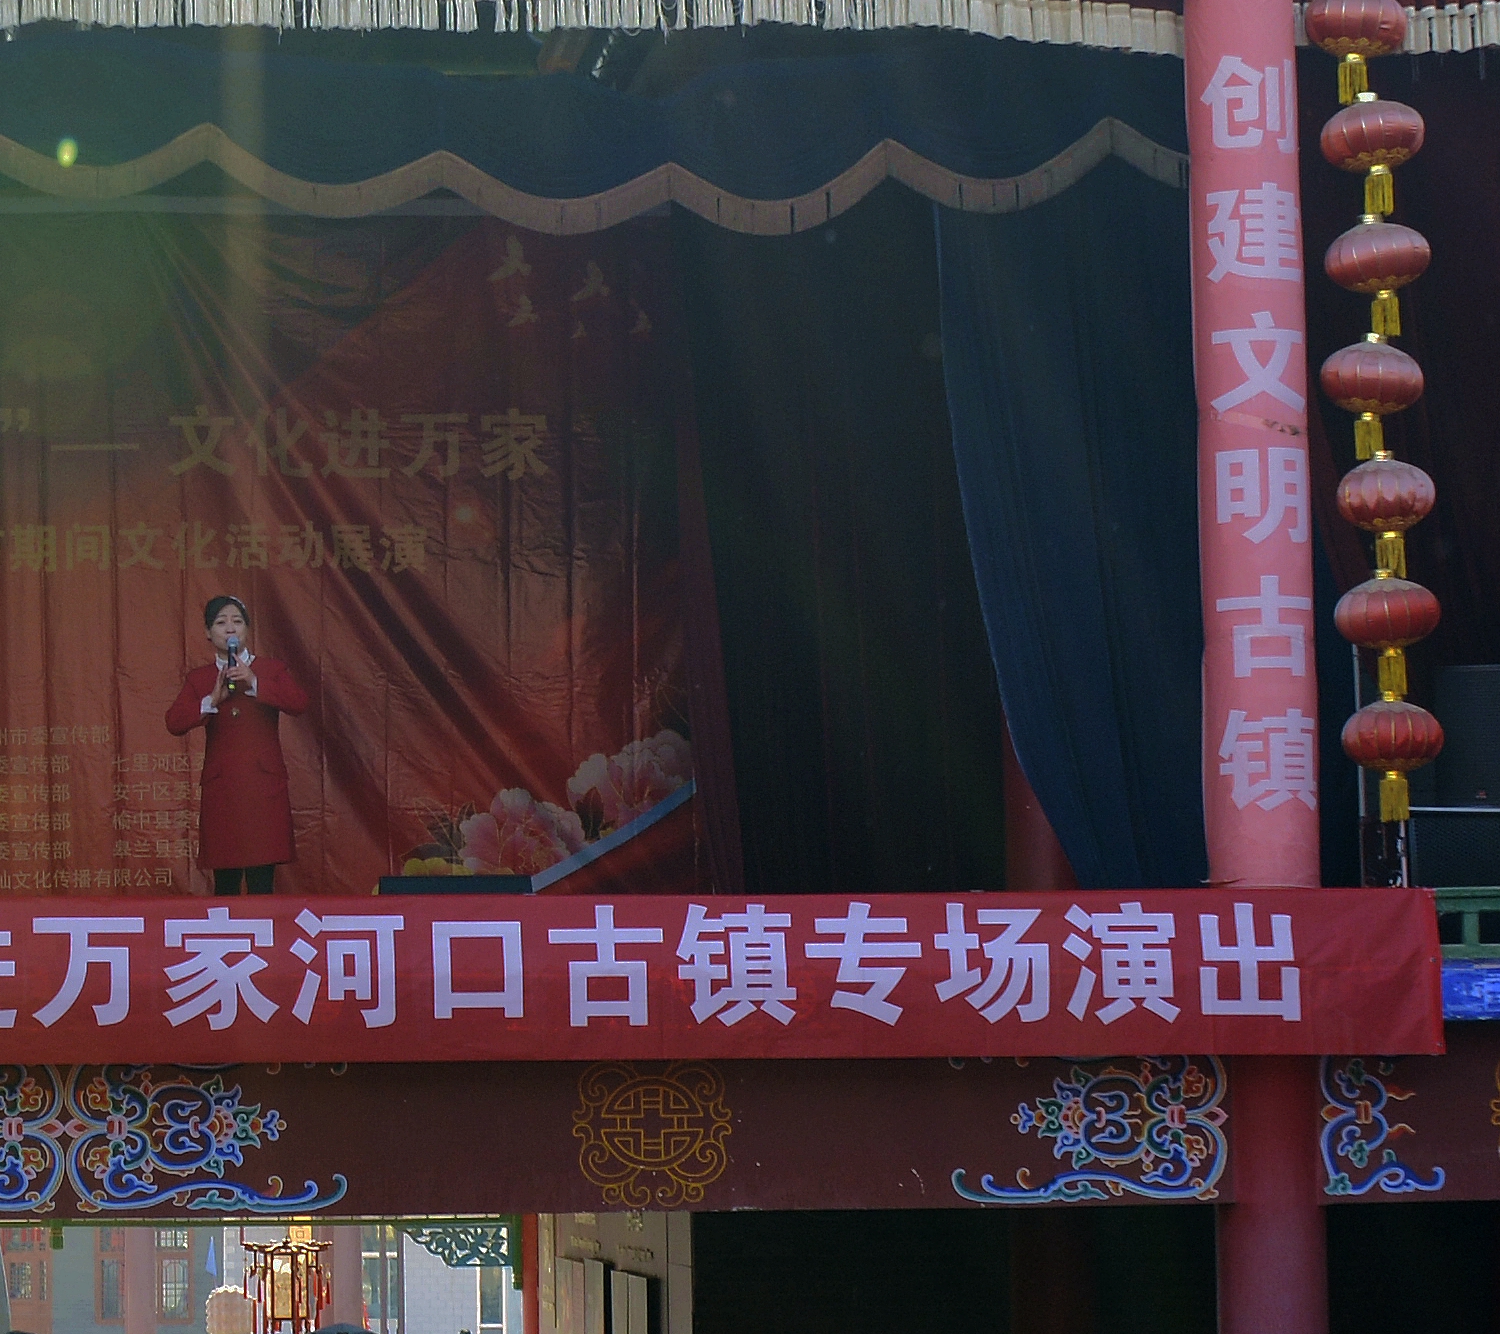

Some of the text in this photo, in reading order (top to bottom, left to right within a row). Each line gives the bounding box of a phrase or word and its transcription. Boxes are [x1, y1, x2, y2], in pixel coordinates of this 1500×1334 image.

[1200, 55, 1317, 812] 创建文明古镇
